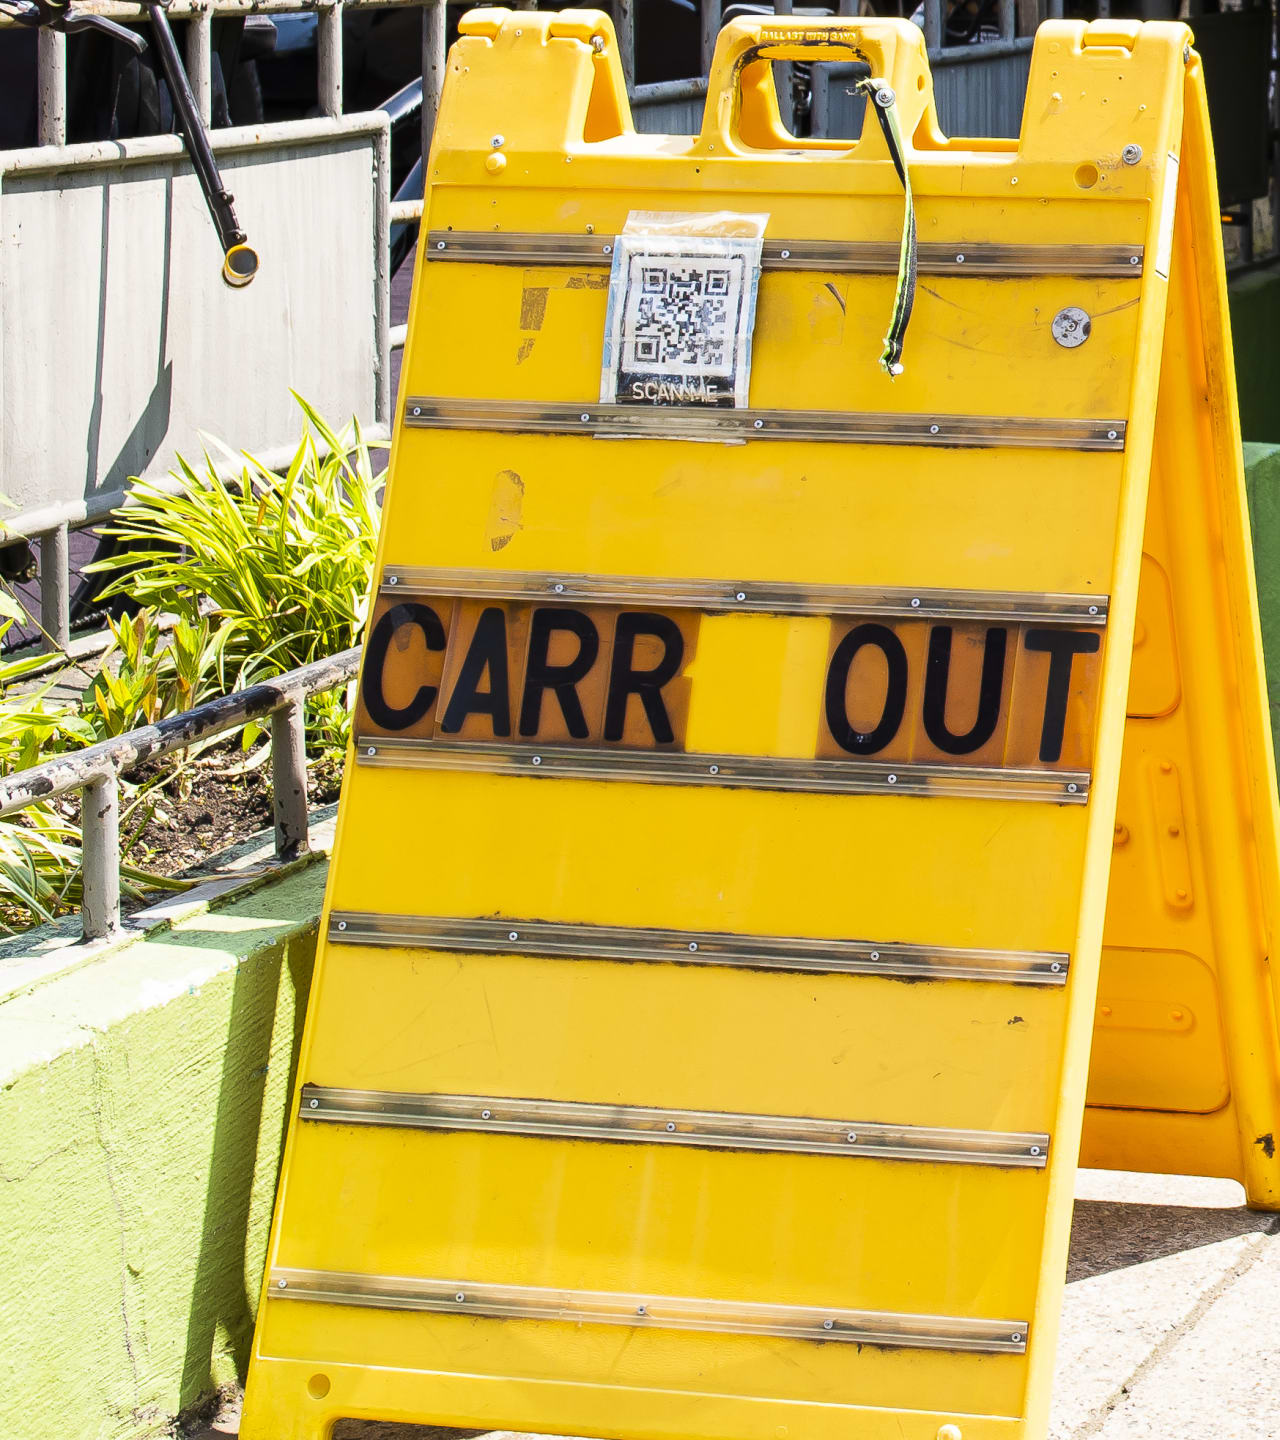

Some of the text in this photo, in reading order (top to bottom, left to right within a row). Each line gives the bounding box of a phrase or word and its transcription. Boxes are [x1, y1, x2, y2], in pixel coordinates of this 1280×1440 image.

[632, 382, 682, 402] SCAN
[362, 603, 1100, 763] CARR OUT
